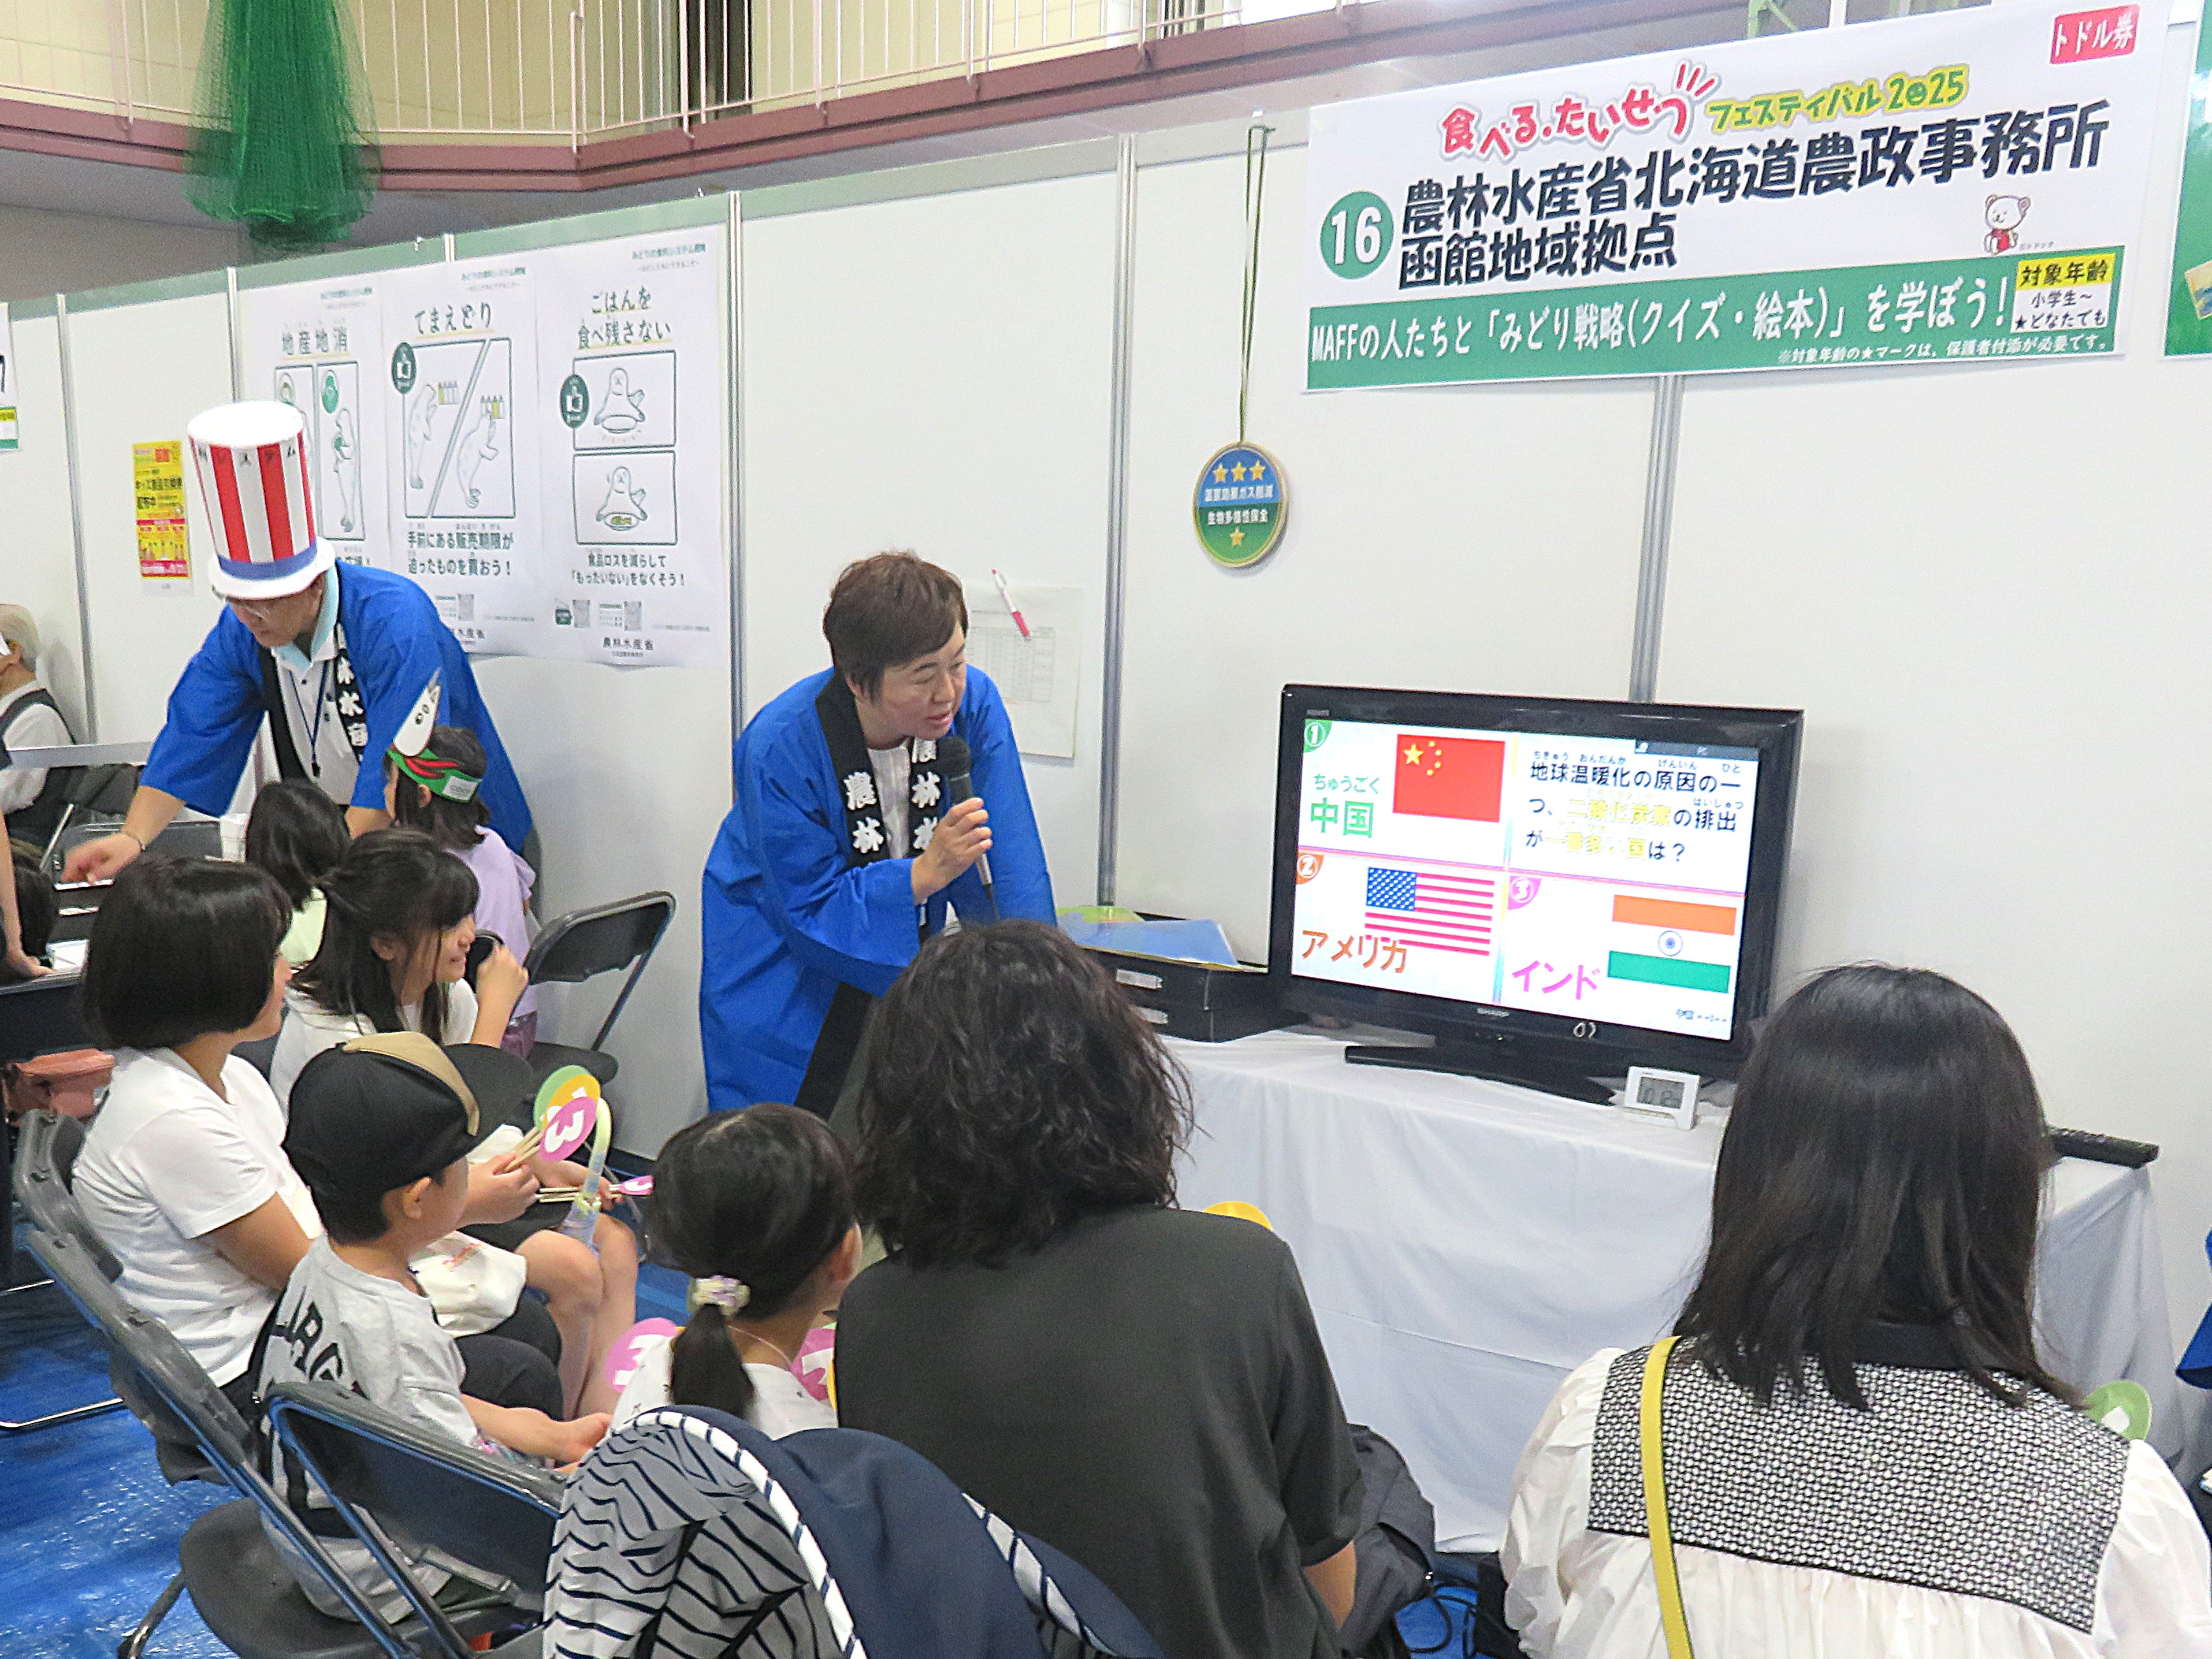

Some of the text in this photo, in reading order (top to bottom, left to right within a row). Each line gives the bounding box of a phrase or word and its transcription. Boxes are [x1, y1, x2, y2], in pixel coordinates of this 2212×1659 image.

[1402, 98, 2111, 235] 農林水産省北海道農政事務所
[1331, 207, 1382, 265] 16
[1399, 211, 1678, 289] 函館地域拠点
[2019, 259, 2108, 287] 対象年齢
[592, 287, 652, 314] ごはんを
[414, 301, 492, 334] てまえどり
[578, 319, 672, 349] 食べ残さない
[1314, 773, 1380, 794] ちゅうごく
[1530, 762, 1741, 793] 地球温暖化の原因の一
[1722, 763, 1741, 773] ひと
[1310, 797, 1374, 838] 中国
[1302, 929, 1408, 973] アメリカ
[1512, 960, 1600, 1000] インド
